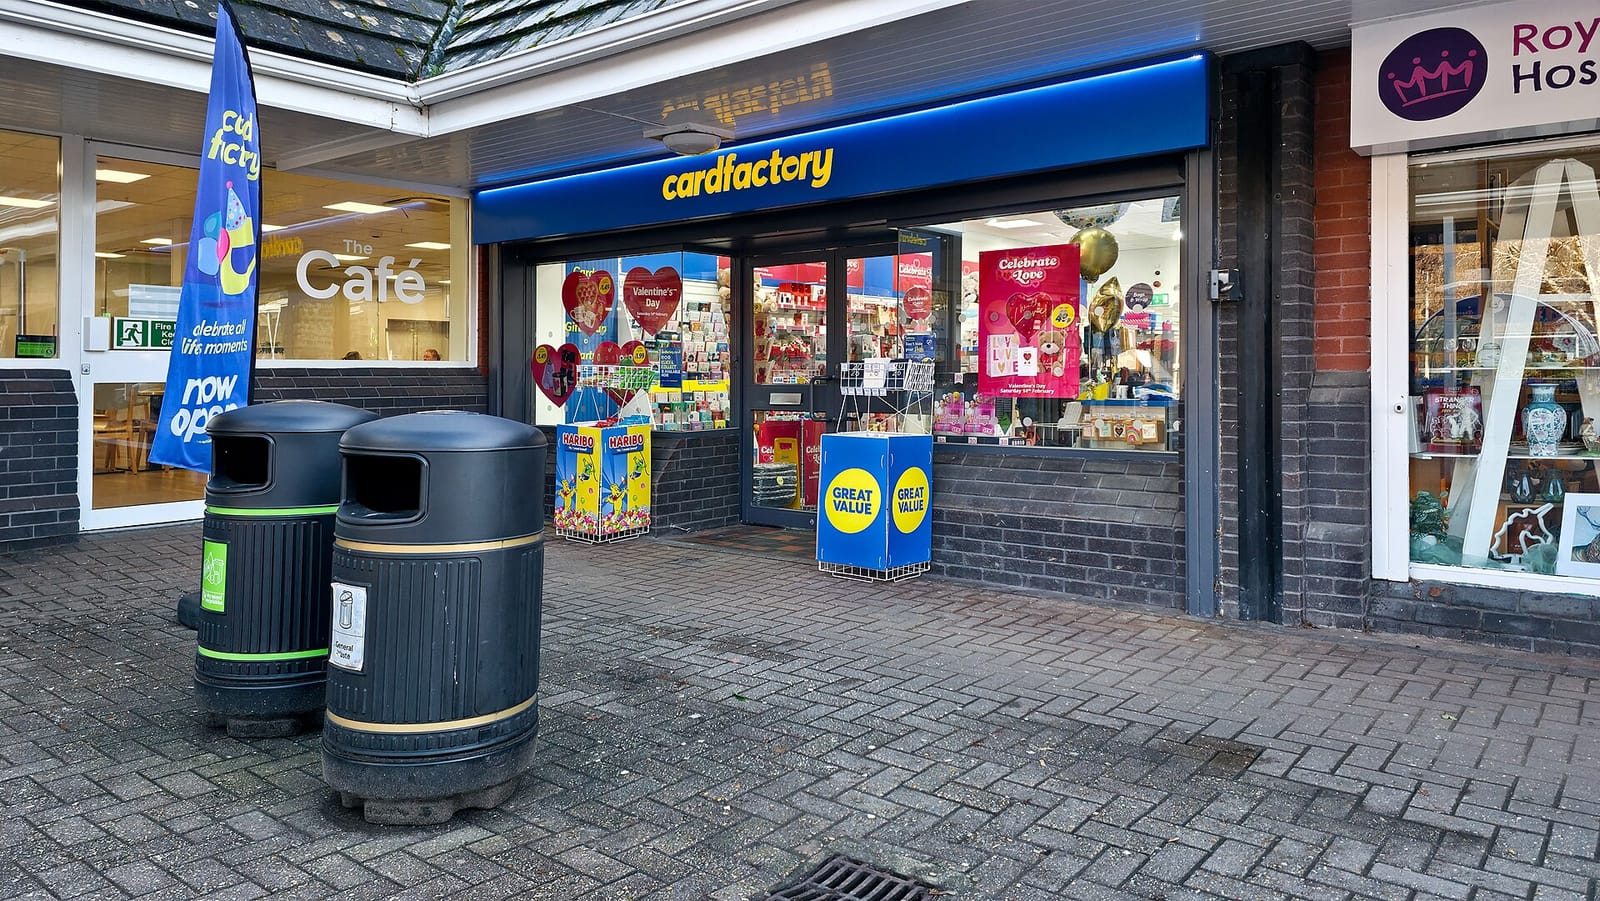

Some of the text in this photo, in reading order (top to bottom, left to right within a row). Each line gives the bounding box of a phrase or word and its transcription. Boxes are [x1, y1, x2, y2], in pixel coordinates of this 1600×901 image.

[662, 148, 834, 201] cardfactory
[343, 239, 373, 254] The
[999, 257, 1058, 270] Celebrate
[296, 249, 426, 305] Café
[1012, 269, 1044, 284] Love
[633, 286, 673, 296] Valentine's
[645, 298, 660, 309] Day
[155, 323, 172, 331] Fire
[203, 339, 248, 355] moments
[181, 375, 238, 405] now
[562, 432, 595, 448] HARIBO
[609, 433, 645, 448] HARIBO
[832, 486, 873, 502] GREAT
[897, 486, 924, 501] GREAT
[833, 499, 872, 515] VALUE
[898, 496, 924, 513] VALUE
[335, 640, 354, 652] General
